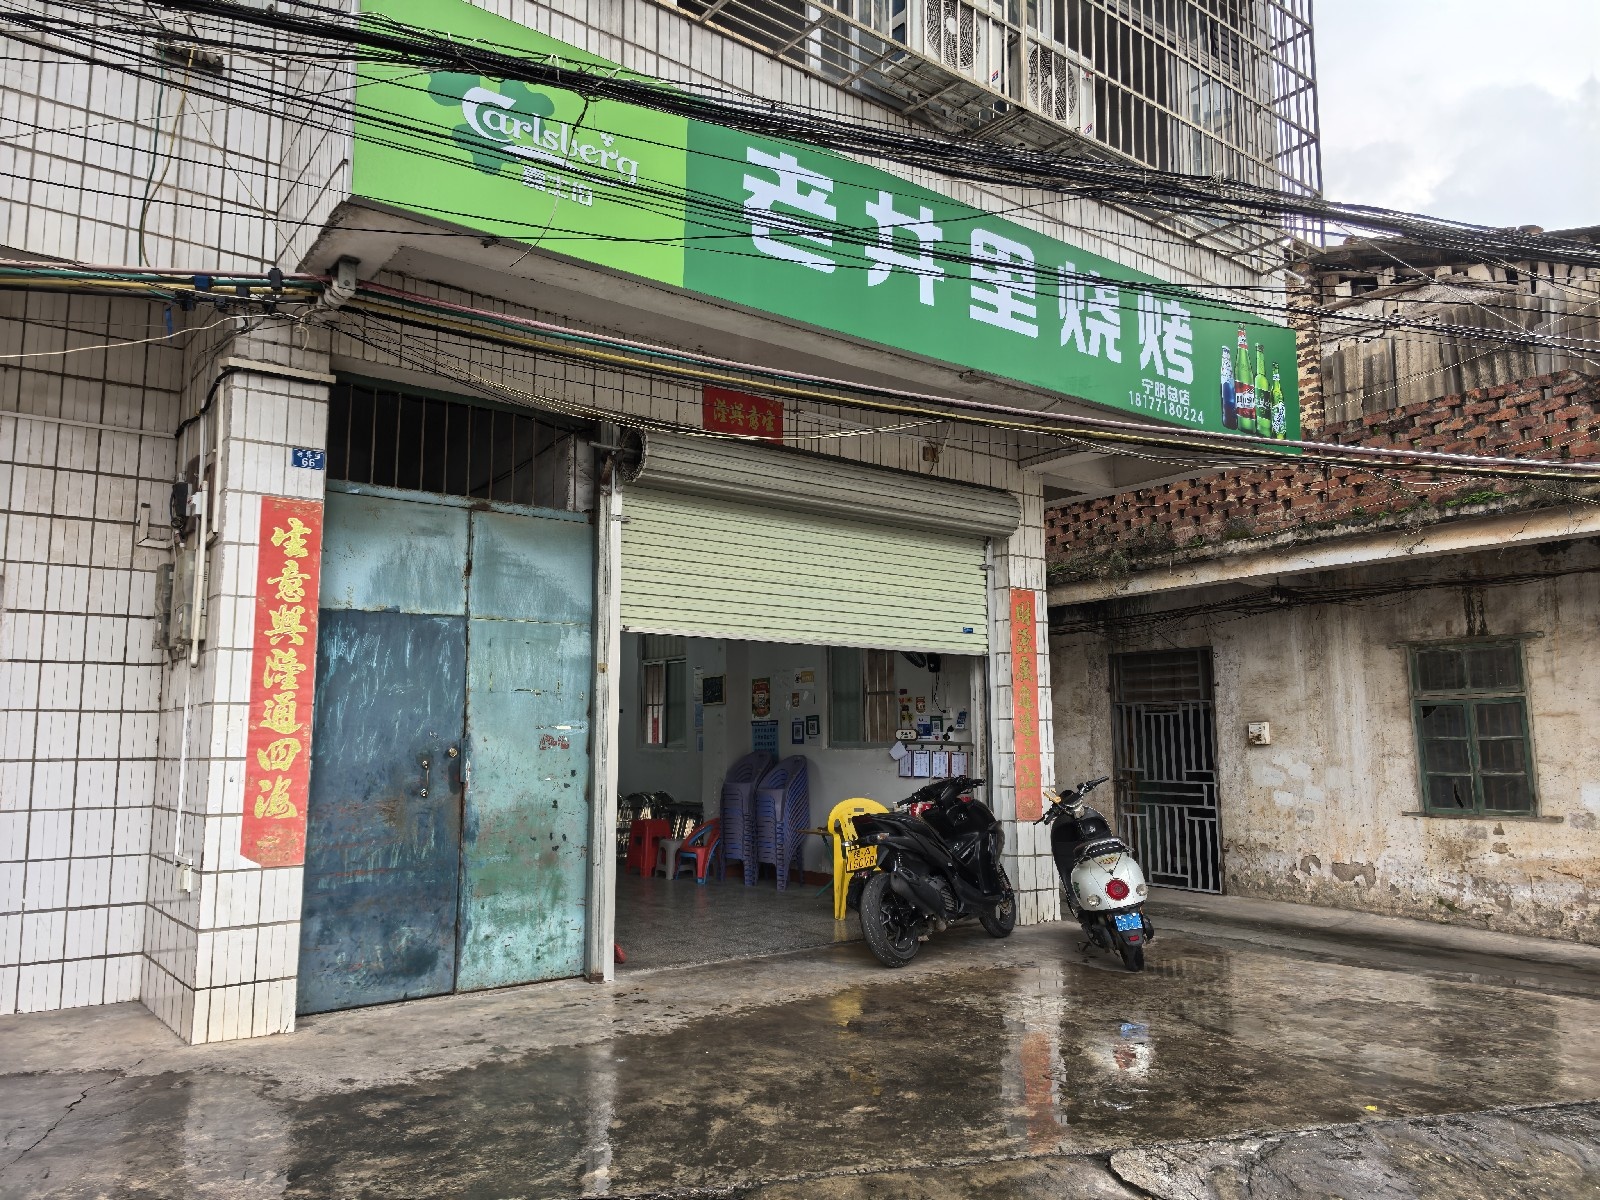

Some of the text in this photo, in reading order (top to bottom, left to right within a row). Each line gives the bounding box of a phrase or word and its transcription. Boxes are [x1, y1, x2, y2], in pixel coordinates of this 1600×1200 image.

[462, 87, 639, 184] Carlsberg
[743, 146, 1194, 385] 老井里烧烤
[1128, 390, 1204, 425] 18177180224
[1141, 378, 1190, 406] 宁明总店
